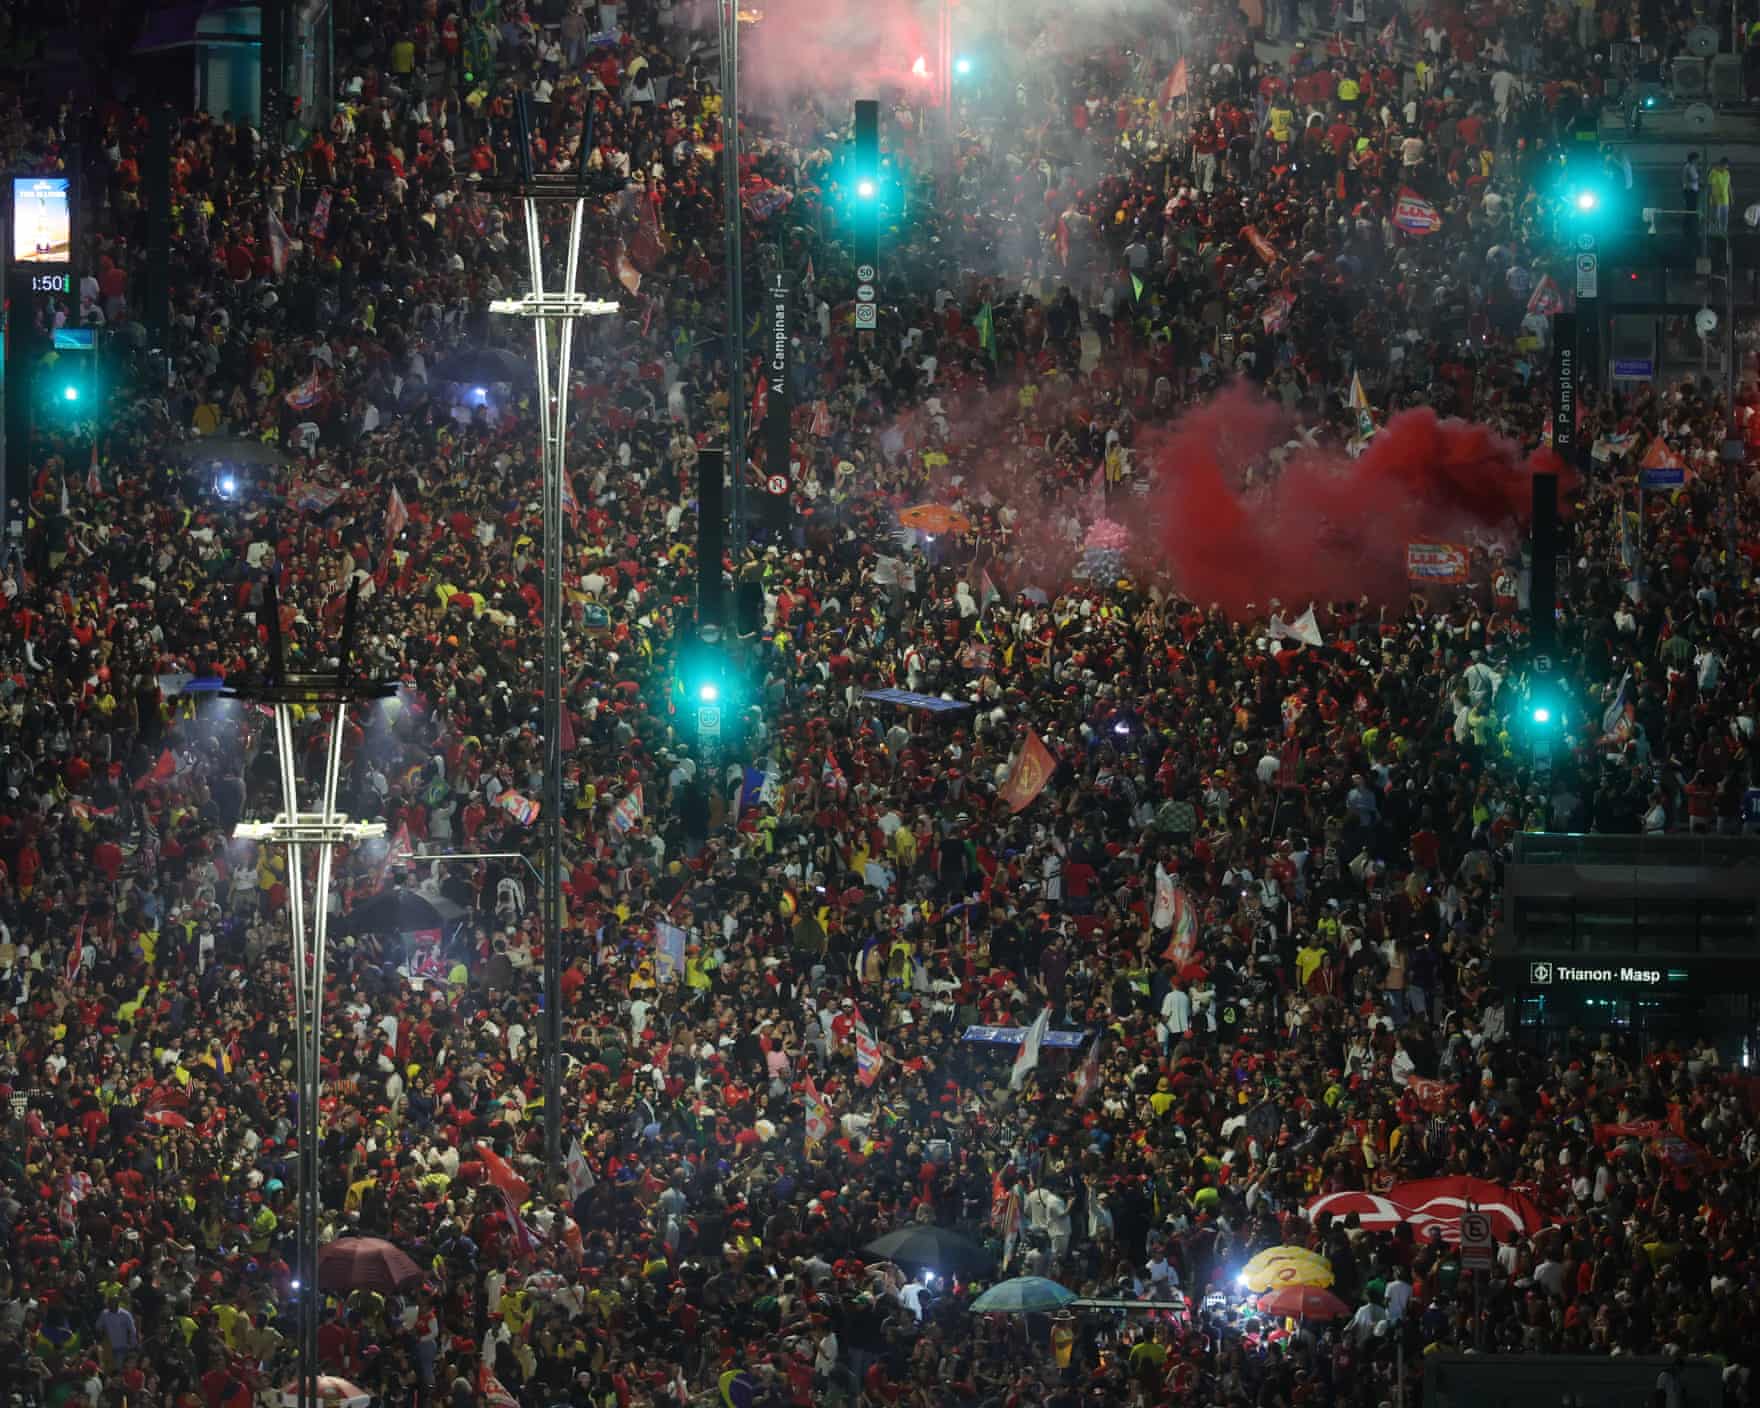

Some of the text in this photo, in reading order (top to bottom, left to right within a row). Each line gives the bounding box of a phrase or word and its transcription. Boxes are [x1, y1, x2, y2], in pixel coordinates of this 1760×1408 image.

[772, 304, 788, 394] Al. Campinas
[1558, 350, 1573, 444] R. Pamplona
